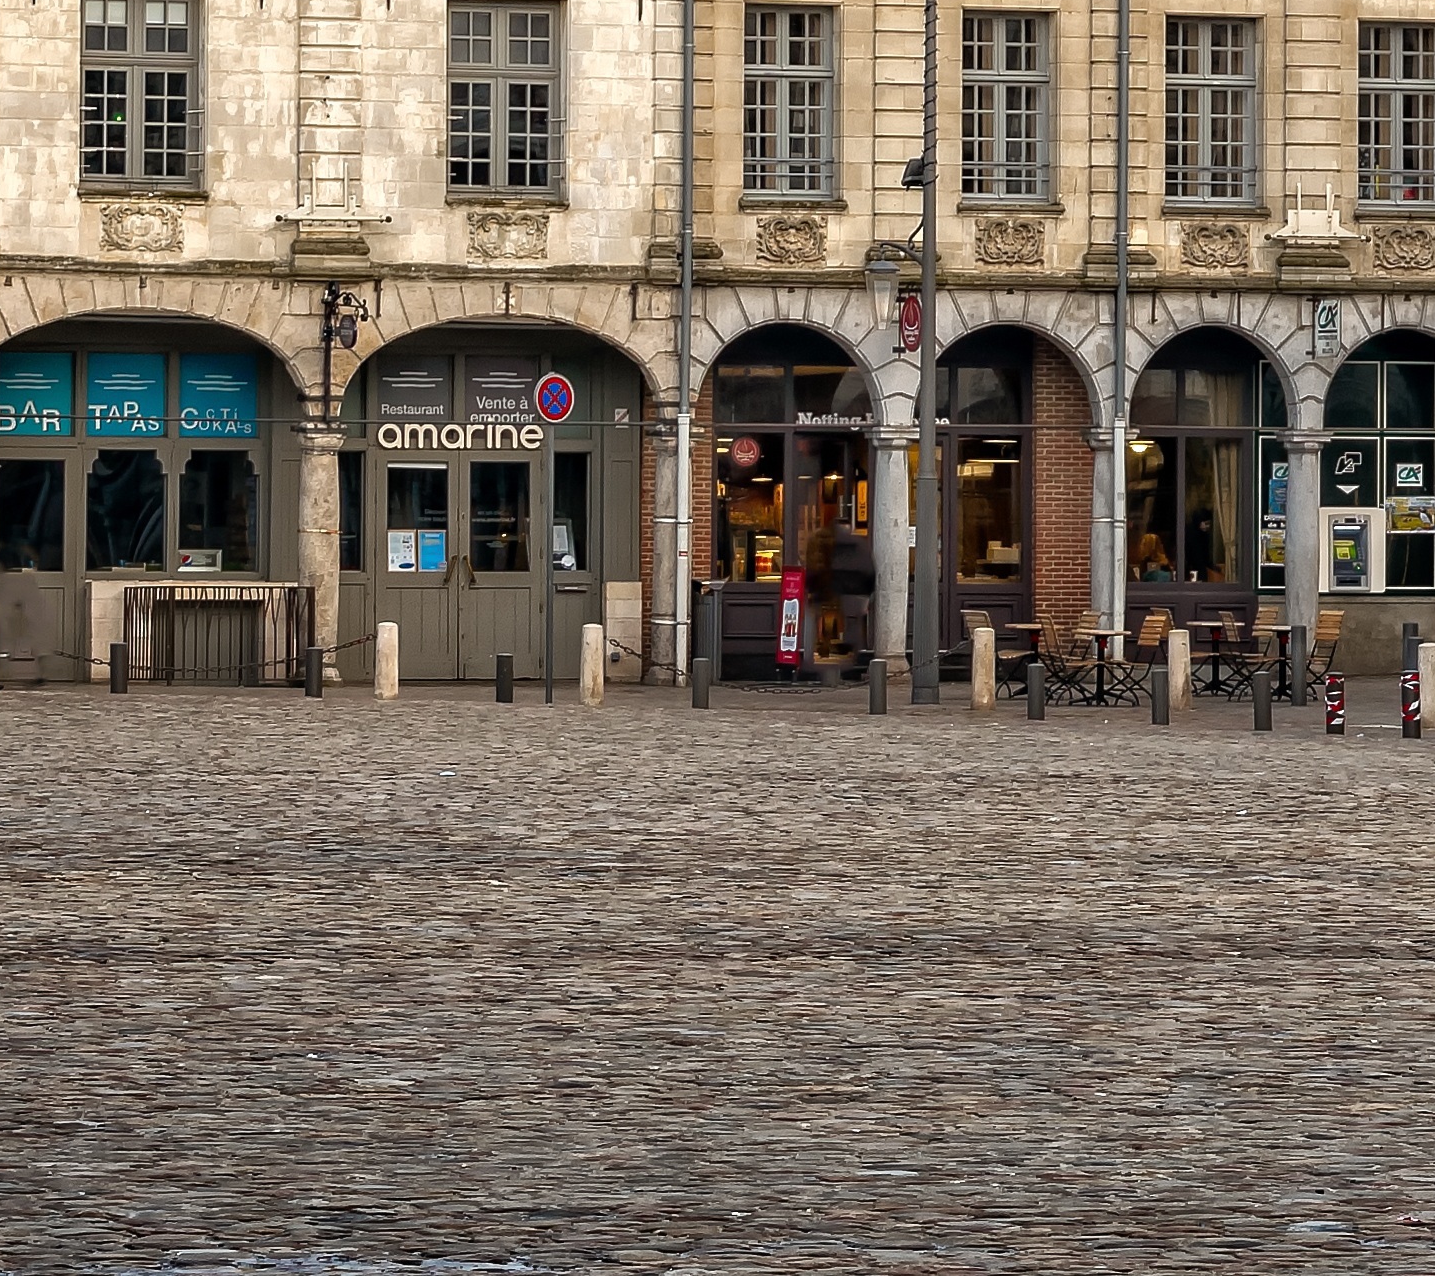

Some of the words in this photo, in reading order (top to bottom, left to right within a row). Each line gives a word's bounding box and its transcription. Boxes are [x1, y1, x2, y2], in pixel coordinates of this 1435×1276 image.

[381, 403, 444, 415] Restaurant
[476, 396, 516, 410] Vente
[519, 396, 529, 410] à
[88, 401, 161, 432] TAPAS
[470, 412, 536, 424] emporter
[795, 412, 863, 431] Notting
[377, 416, 544, 449] amarine
